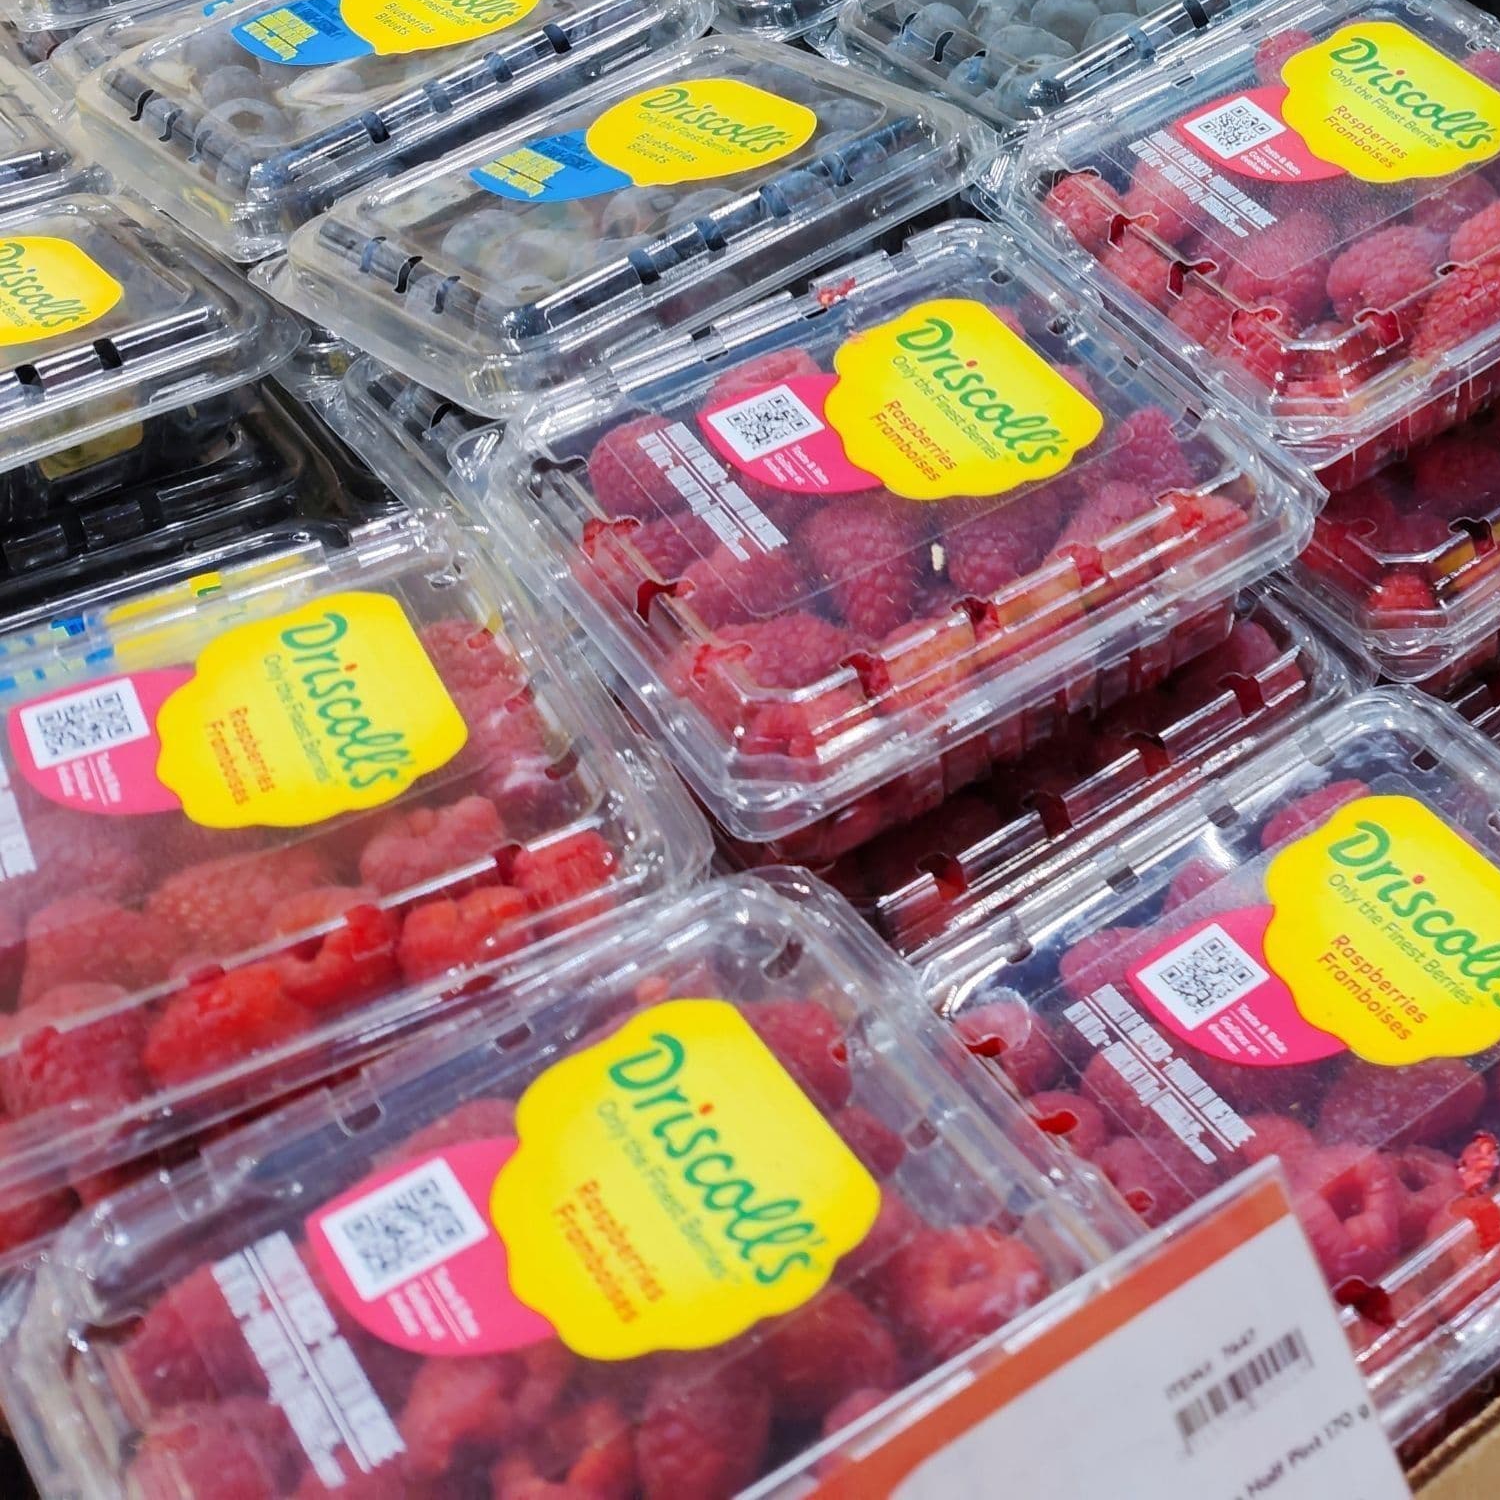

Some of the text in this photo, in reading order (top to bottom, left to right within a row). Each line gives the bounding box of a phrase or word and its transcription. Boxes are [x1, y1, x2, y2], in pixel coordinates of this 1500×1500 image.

[374, 12, 410, 36] Bleuets
[384, 2, 435, 35] Blueberries
[641, 88, 794, 154] Driscoll's
[1330, 37, 1497, 150] Driscoll's
[1330, 67, 1443, 149] Only the Finest Berries
[1333, 104, 1408, 160] Raspberries
[627, 142, 670, 165] Bleuets
[636, 132, 698, 163] Blueberries
[1323, 115, 1395, 169] Framboises
[892, 355, 1001, 460] Only the Finest Berries
[896, 318, 1069, 464] Driscoll's
[871, 412, 942, 482] Framboises
[884, 400, 958, 471] Raspberries
[281, 612, 416, 789] Driscoll's
[204, 719, 250, 806] Framboises
[229, 706, 277, 793] Raspberries
[1328, 873, 1475, 1006] Only the Finest Berries
[1330, 934, 1428, 1025] Raspberries
[1317, 952, 1413, 1042] Framboises
[608, 1032, 828, 1285] Driscoll's
[553, 1203, 638, 1324] Framboises
[576, 1180, 666, 1303] Raspberries
[1247, 1460, 1285, 1498] Half
[1287, 1436, 1322, 1468] Pint
